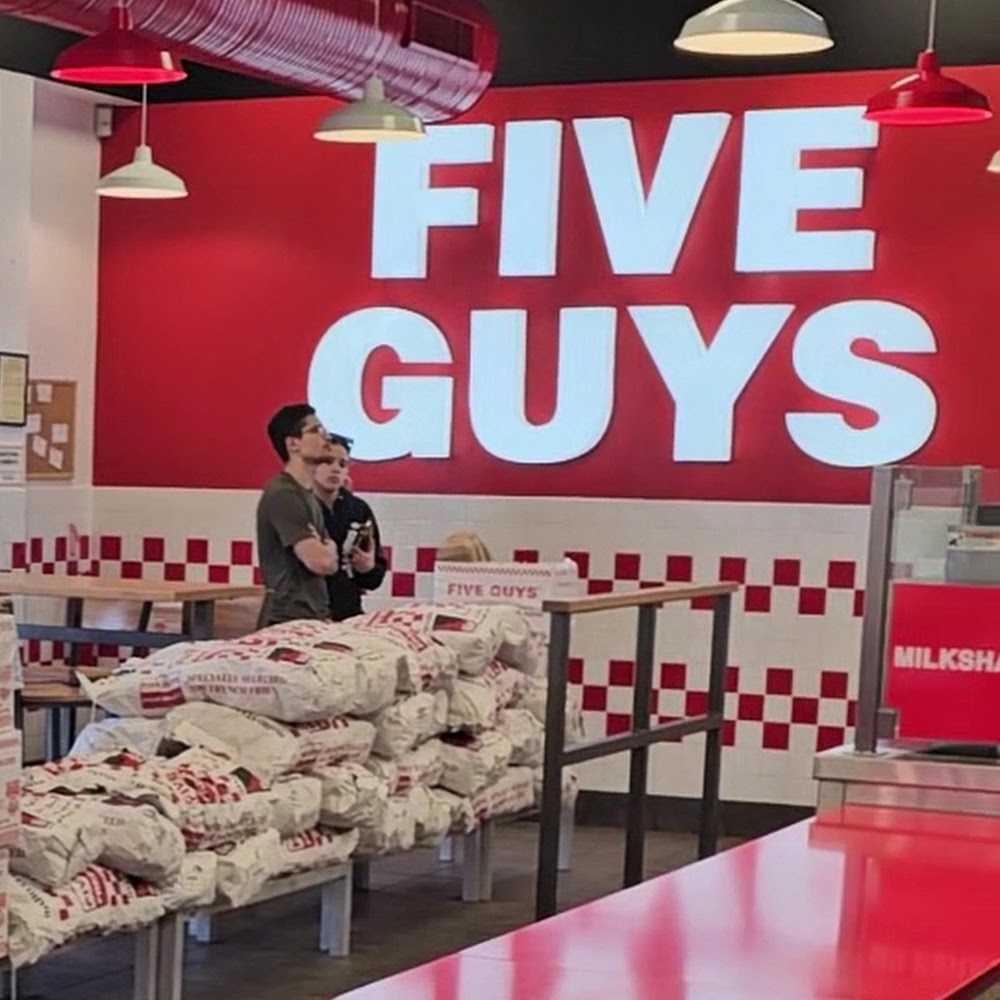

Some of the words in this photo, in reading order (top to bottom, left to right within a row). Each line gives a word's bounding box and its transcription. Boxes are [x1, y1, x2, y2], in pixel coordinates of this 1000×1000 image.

[371, 105, 879, 279] FIVE
[307, 299, 938, 469] GUYS
[447, 582, 484, 598] FIVE
[489, 583, 538, 599] GUYS
